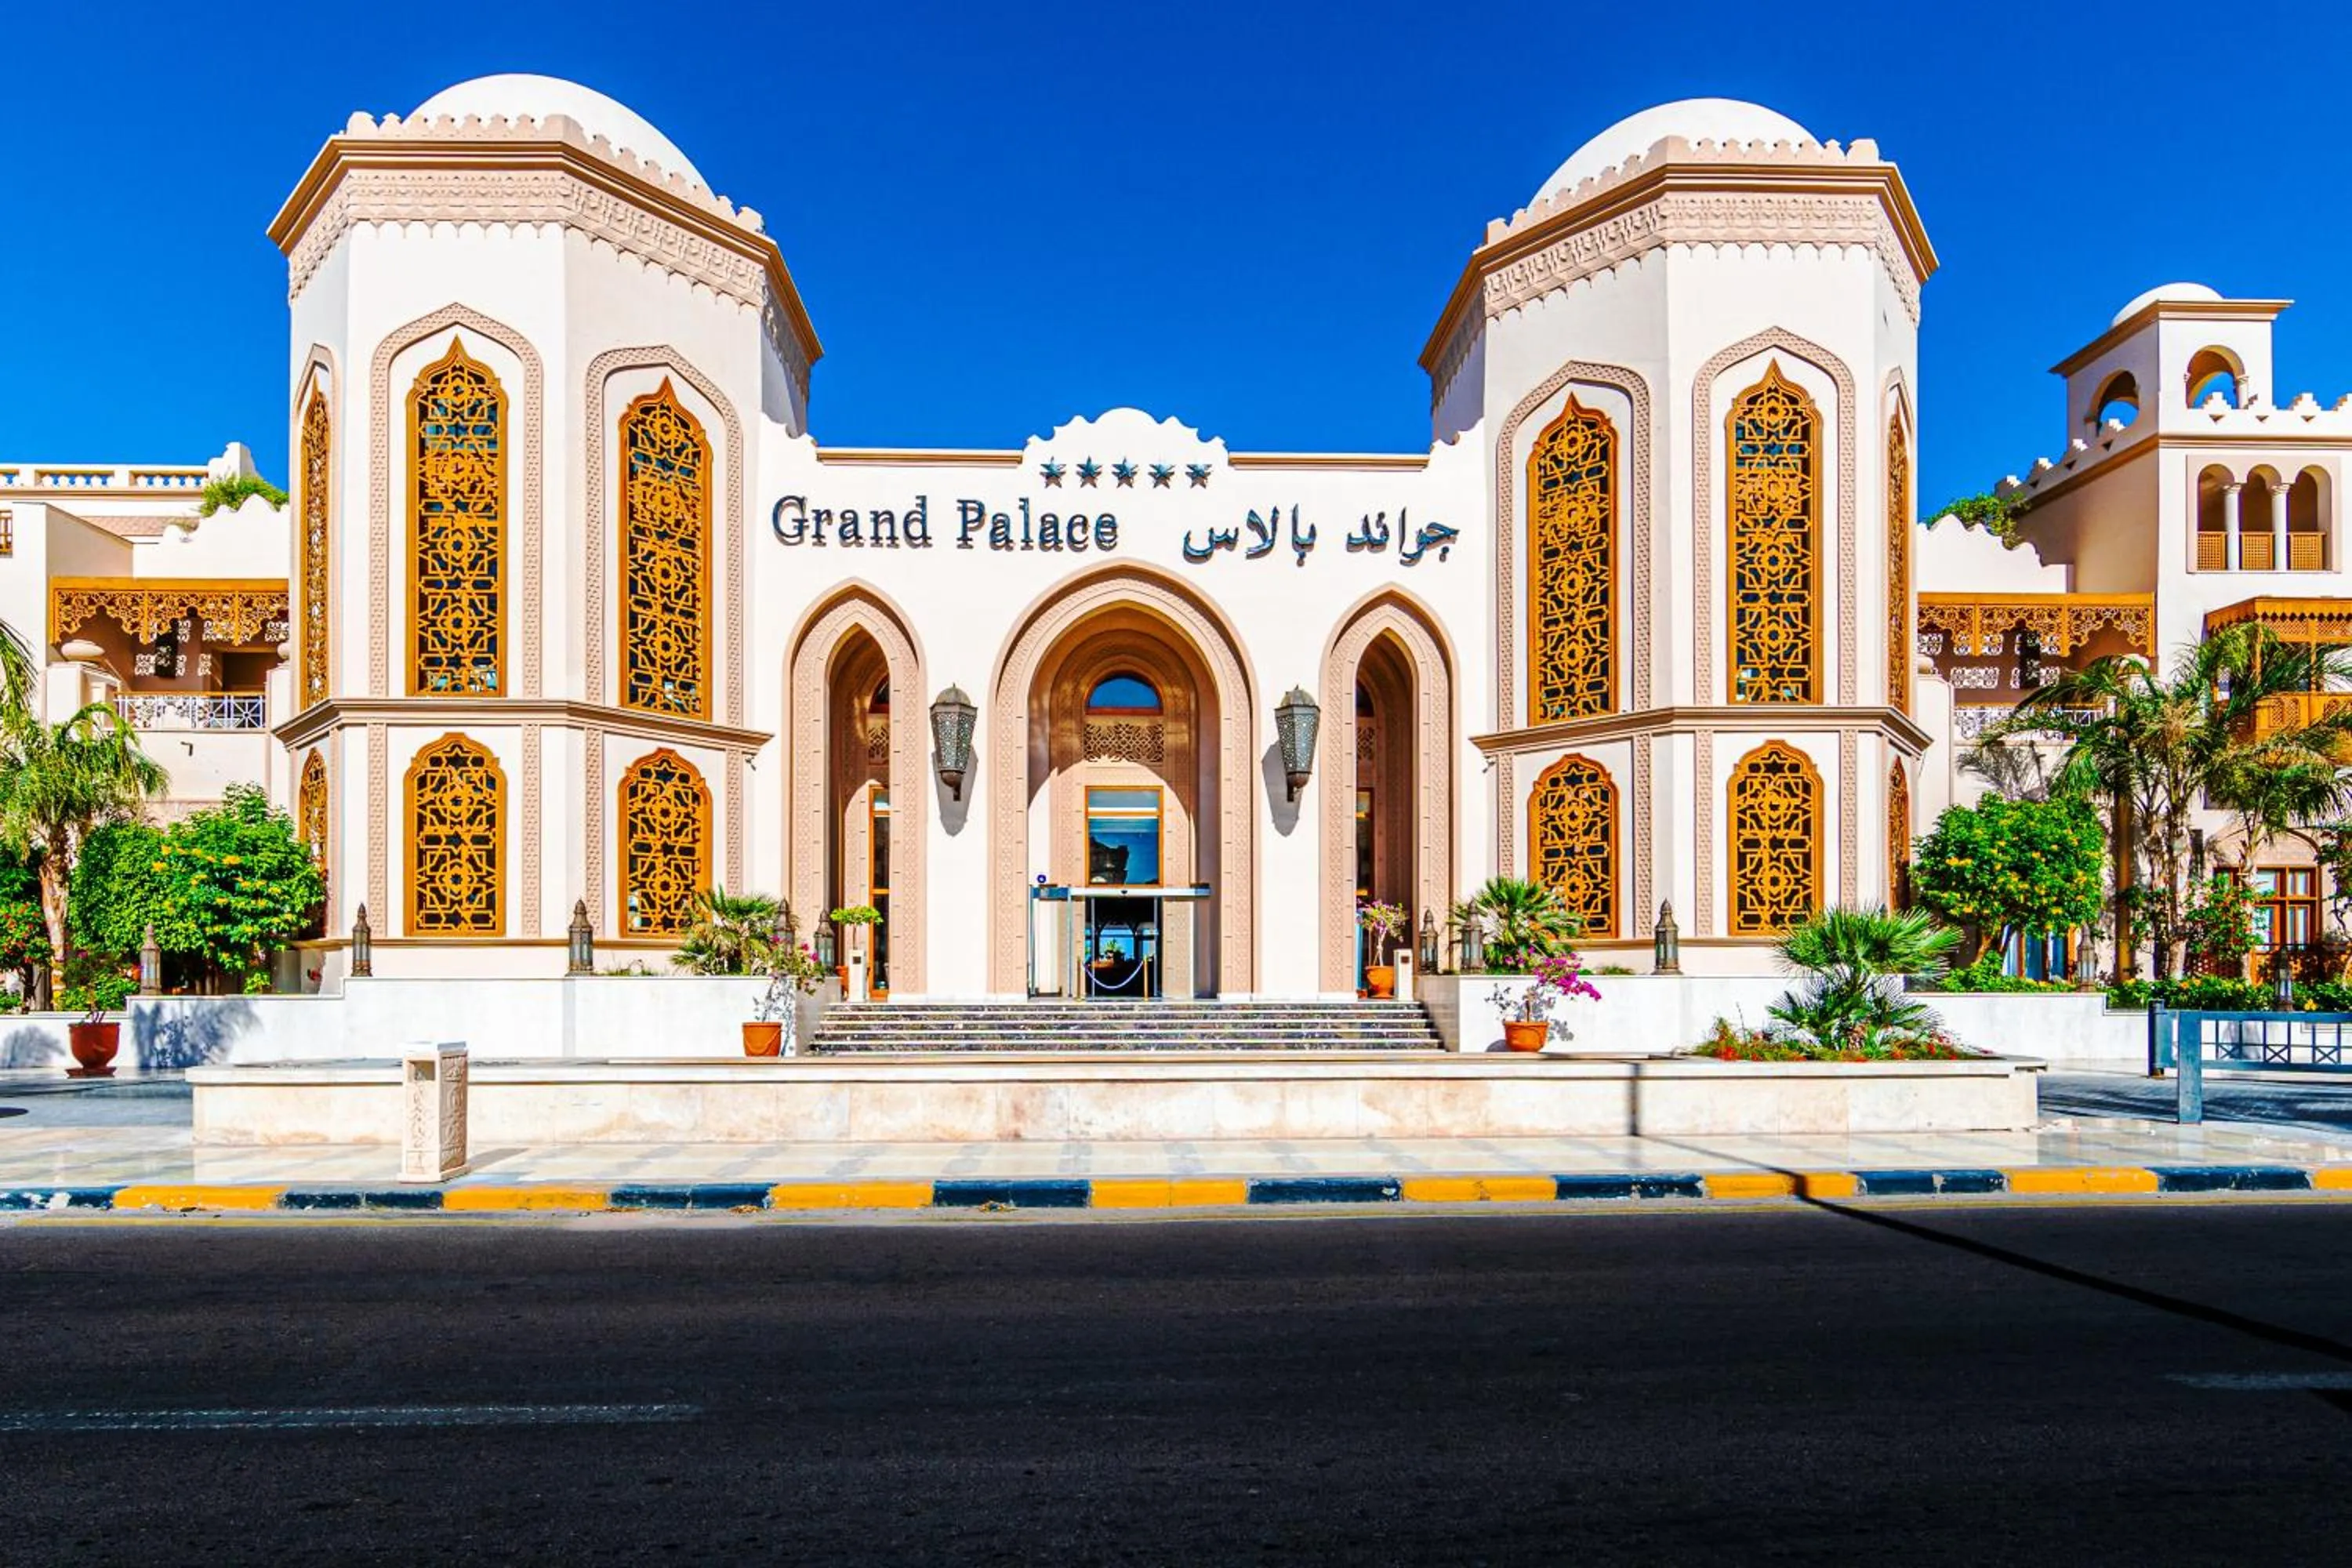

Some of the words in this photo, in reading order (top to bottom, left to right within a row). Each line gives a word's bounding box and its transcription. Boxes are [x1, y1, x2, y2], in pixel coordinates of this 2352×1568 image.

[772, 495, 931, 546] Grand
[956, 497, 1118, 550] Palace
[1183, 503, 1316, 562] بالاس
[1346, 507, 1459, 562] جراند
